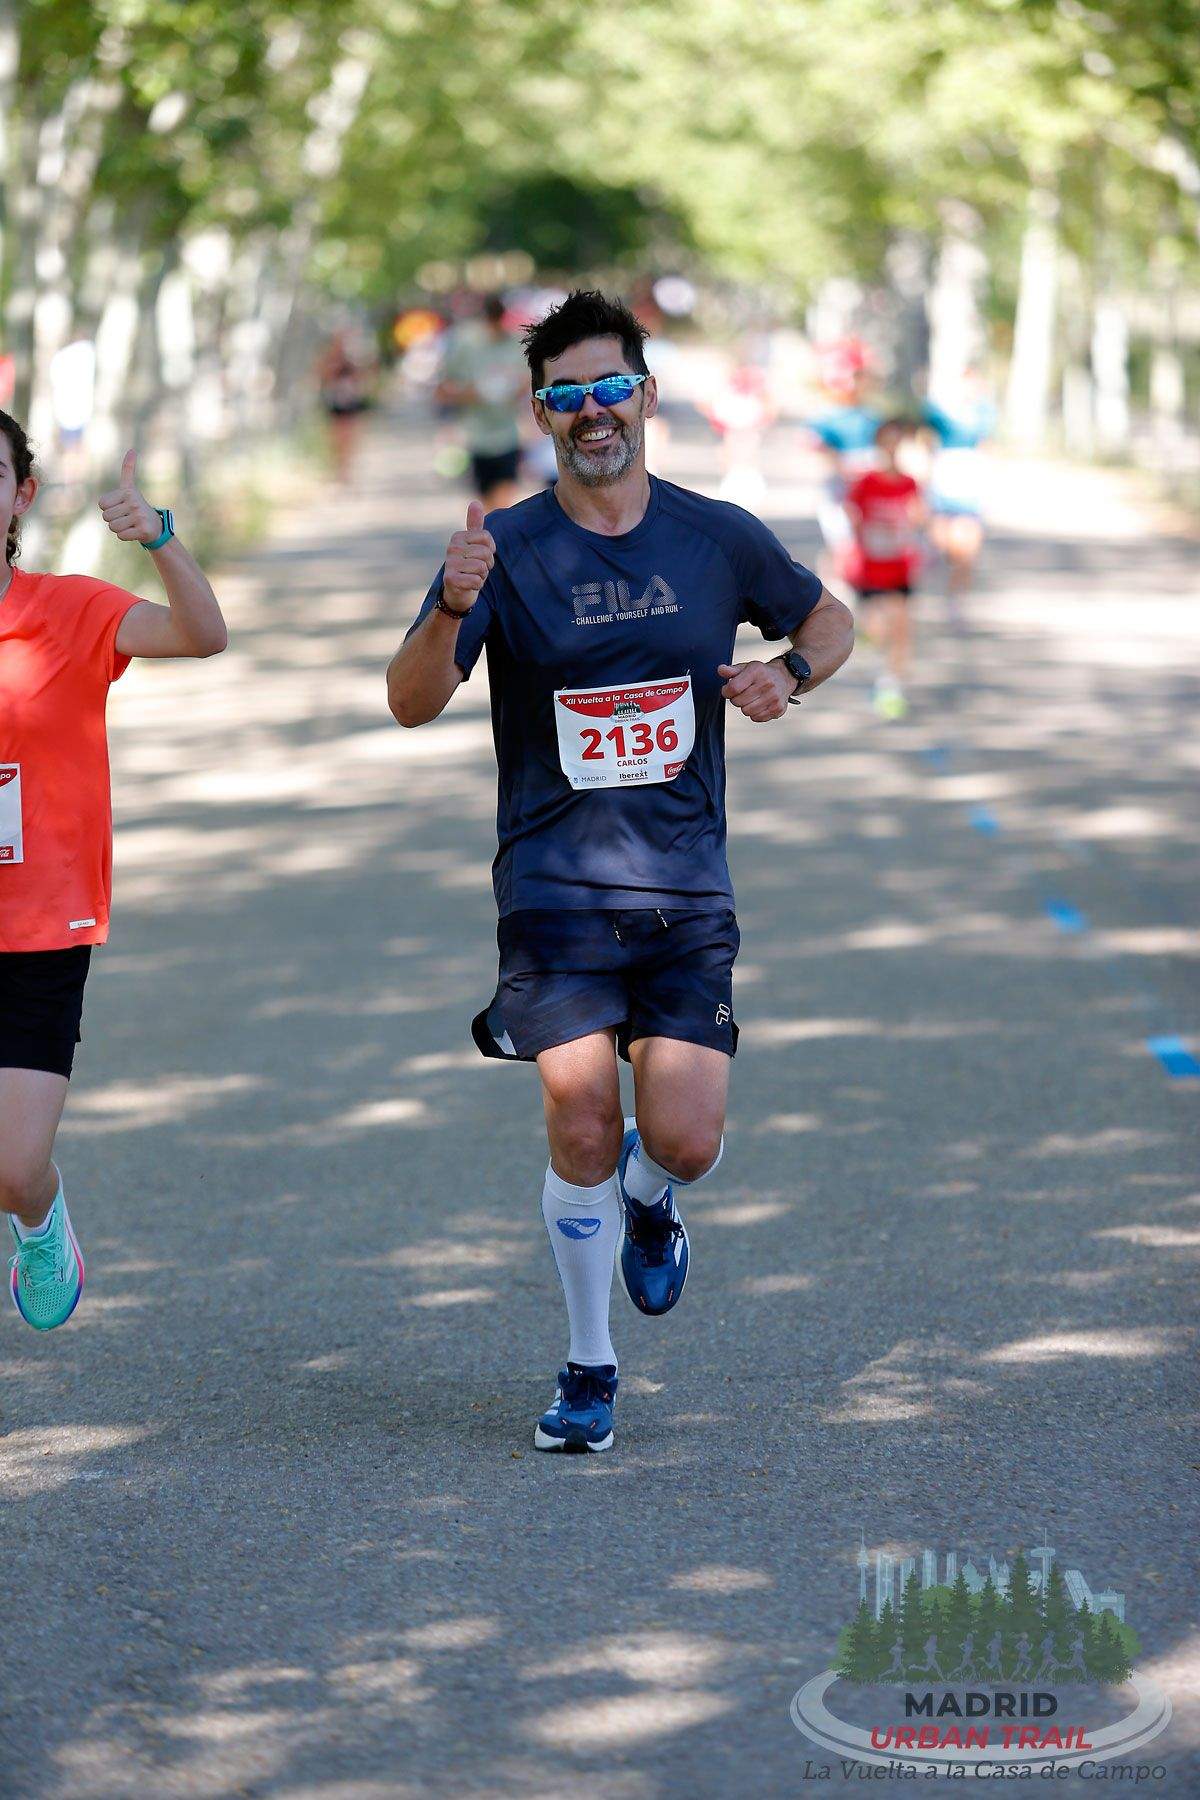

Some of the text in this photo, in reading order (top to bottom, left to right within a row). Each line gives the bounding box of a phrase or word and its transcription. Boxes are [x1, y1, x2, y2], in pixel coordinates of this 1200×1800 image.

[571, 574, 676, 617] FILA
[615, 609, 648, 621] YOURSELF
[650, 606, 665, 616] AND
[565, 697, 576, 706] XII
[577, 696, 604, 705] Vuelta
[623, 692, 644, 700] Casa
[645, 689, 655, 697] de
[656, 686, 683, 696] Campo
[579, 719, 679, 760] 2136
[616, 758, 648, 767] CARLOS
[581, 775, 607, 783] MADRID
